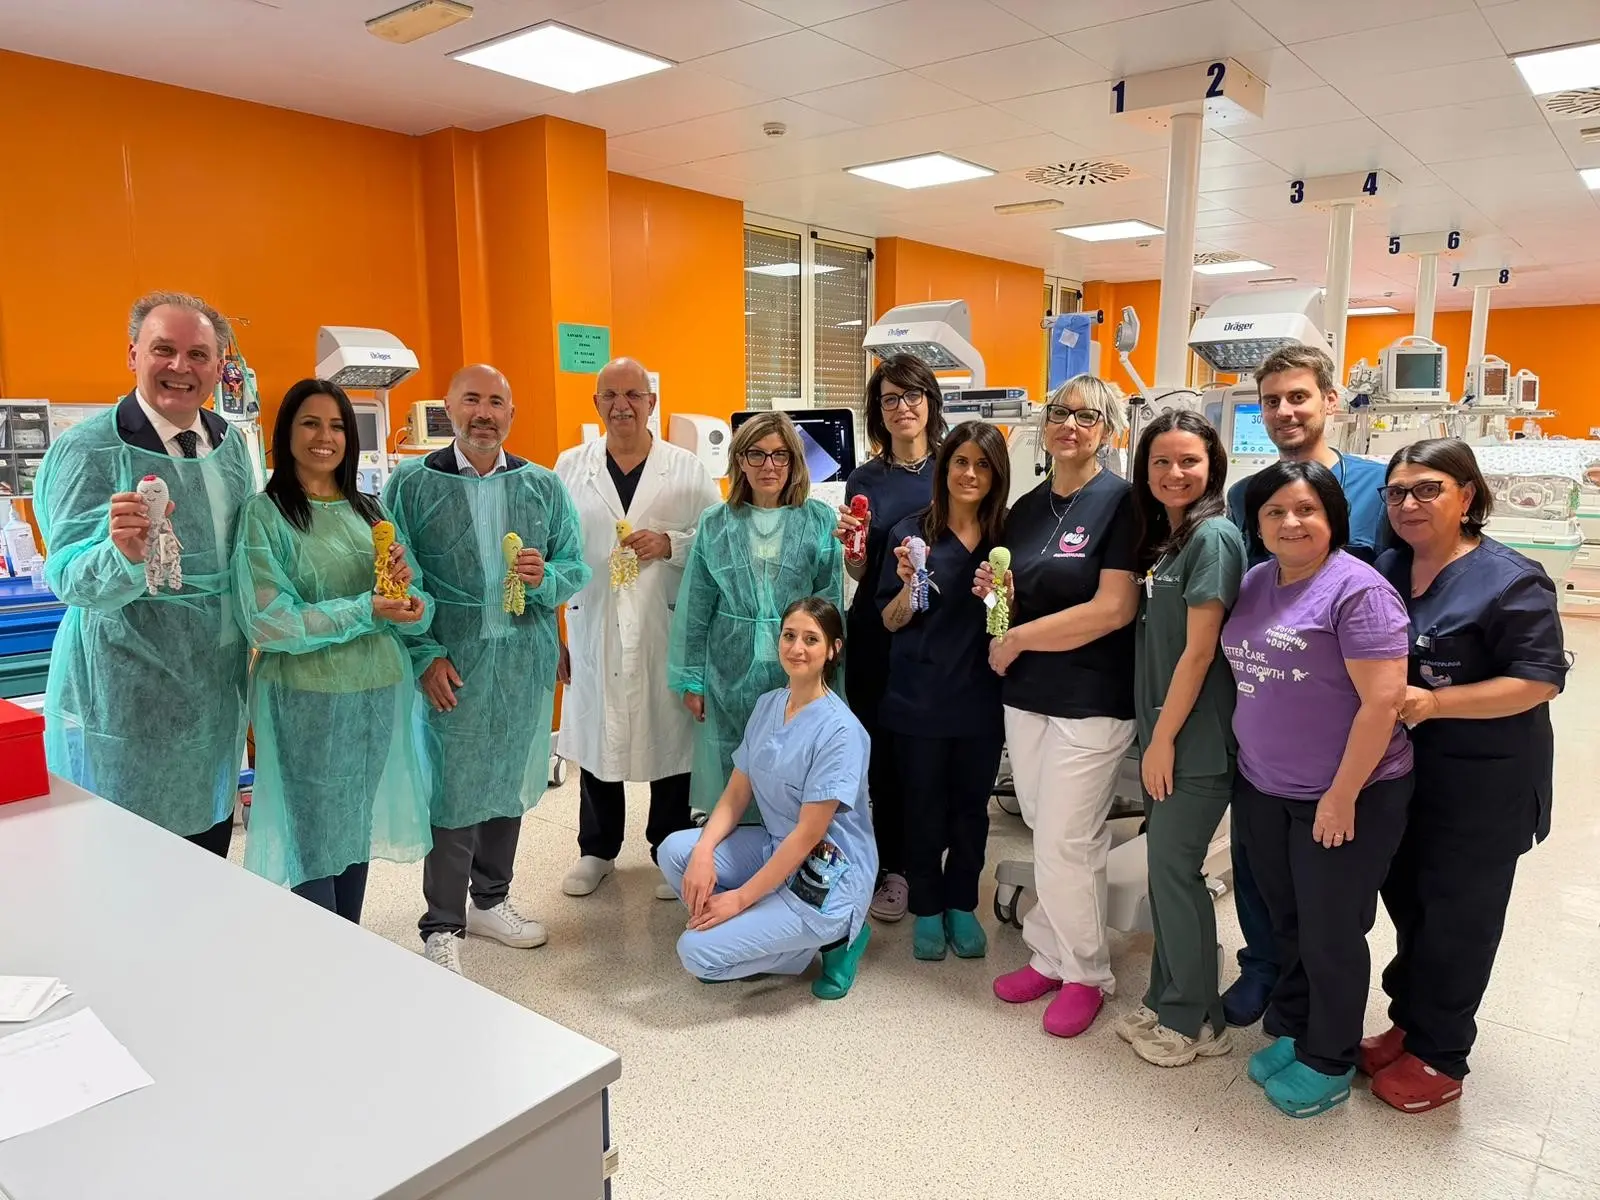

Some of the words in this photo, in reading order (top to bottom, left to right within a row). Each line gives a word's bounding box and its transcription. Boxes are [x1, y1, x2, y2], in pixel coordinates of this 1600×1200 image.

[1112, 80, 1125, 113] 1
[1206, 62, 1226, 98] 2
[1290, 180, 1305, 204] 3
[1362, 171, 1378, 196] 4
[1388, 236, 1401, 255] 5
[1447, 231, 1460, 250] 6
[1452, 272, 1460, 287] 7
[1499, 269, 1510, 284] 8
[1223, 321, 1255, 332] Dräger
[1224, 646, 1244, 658] ETTER
[1246, 663, 1285, 681] GROWTH
